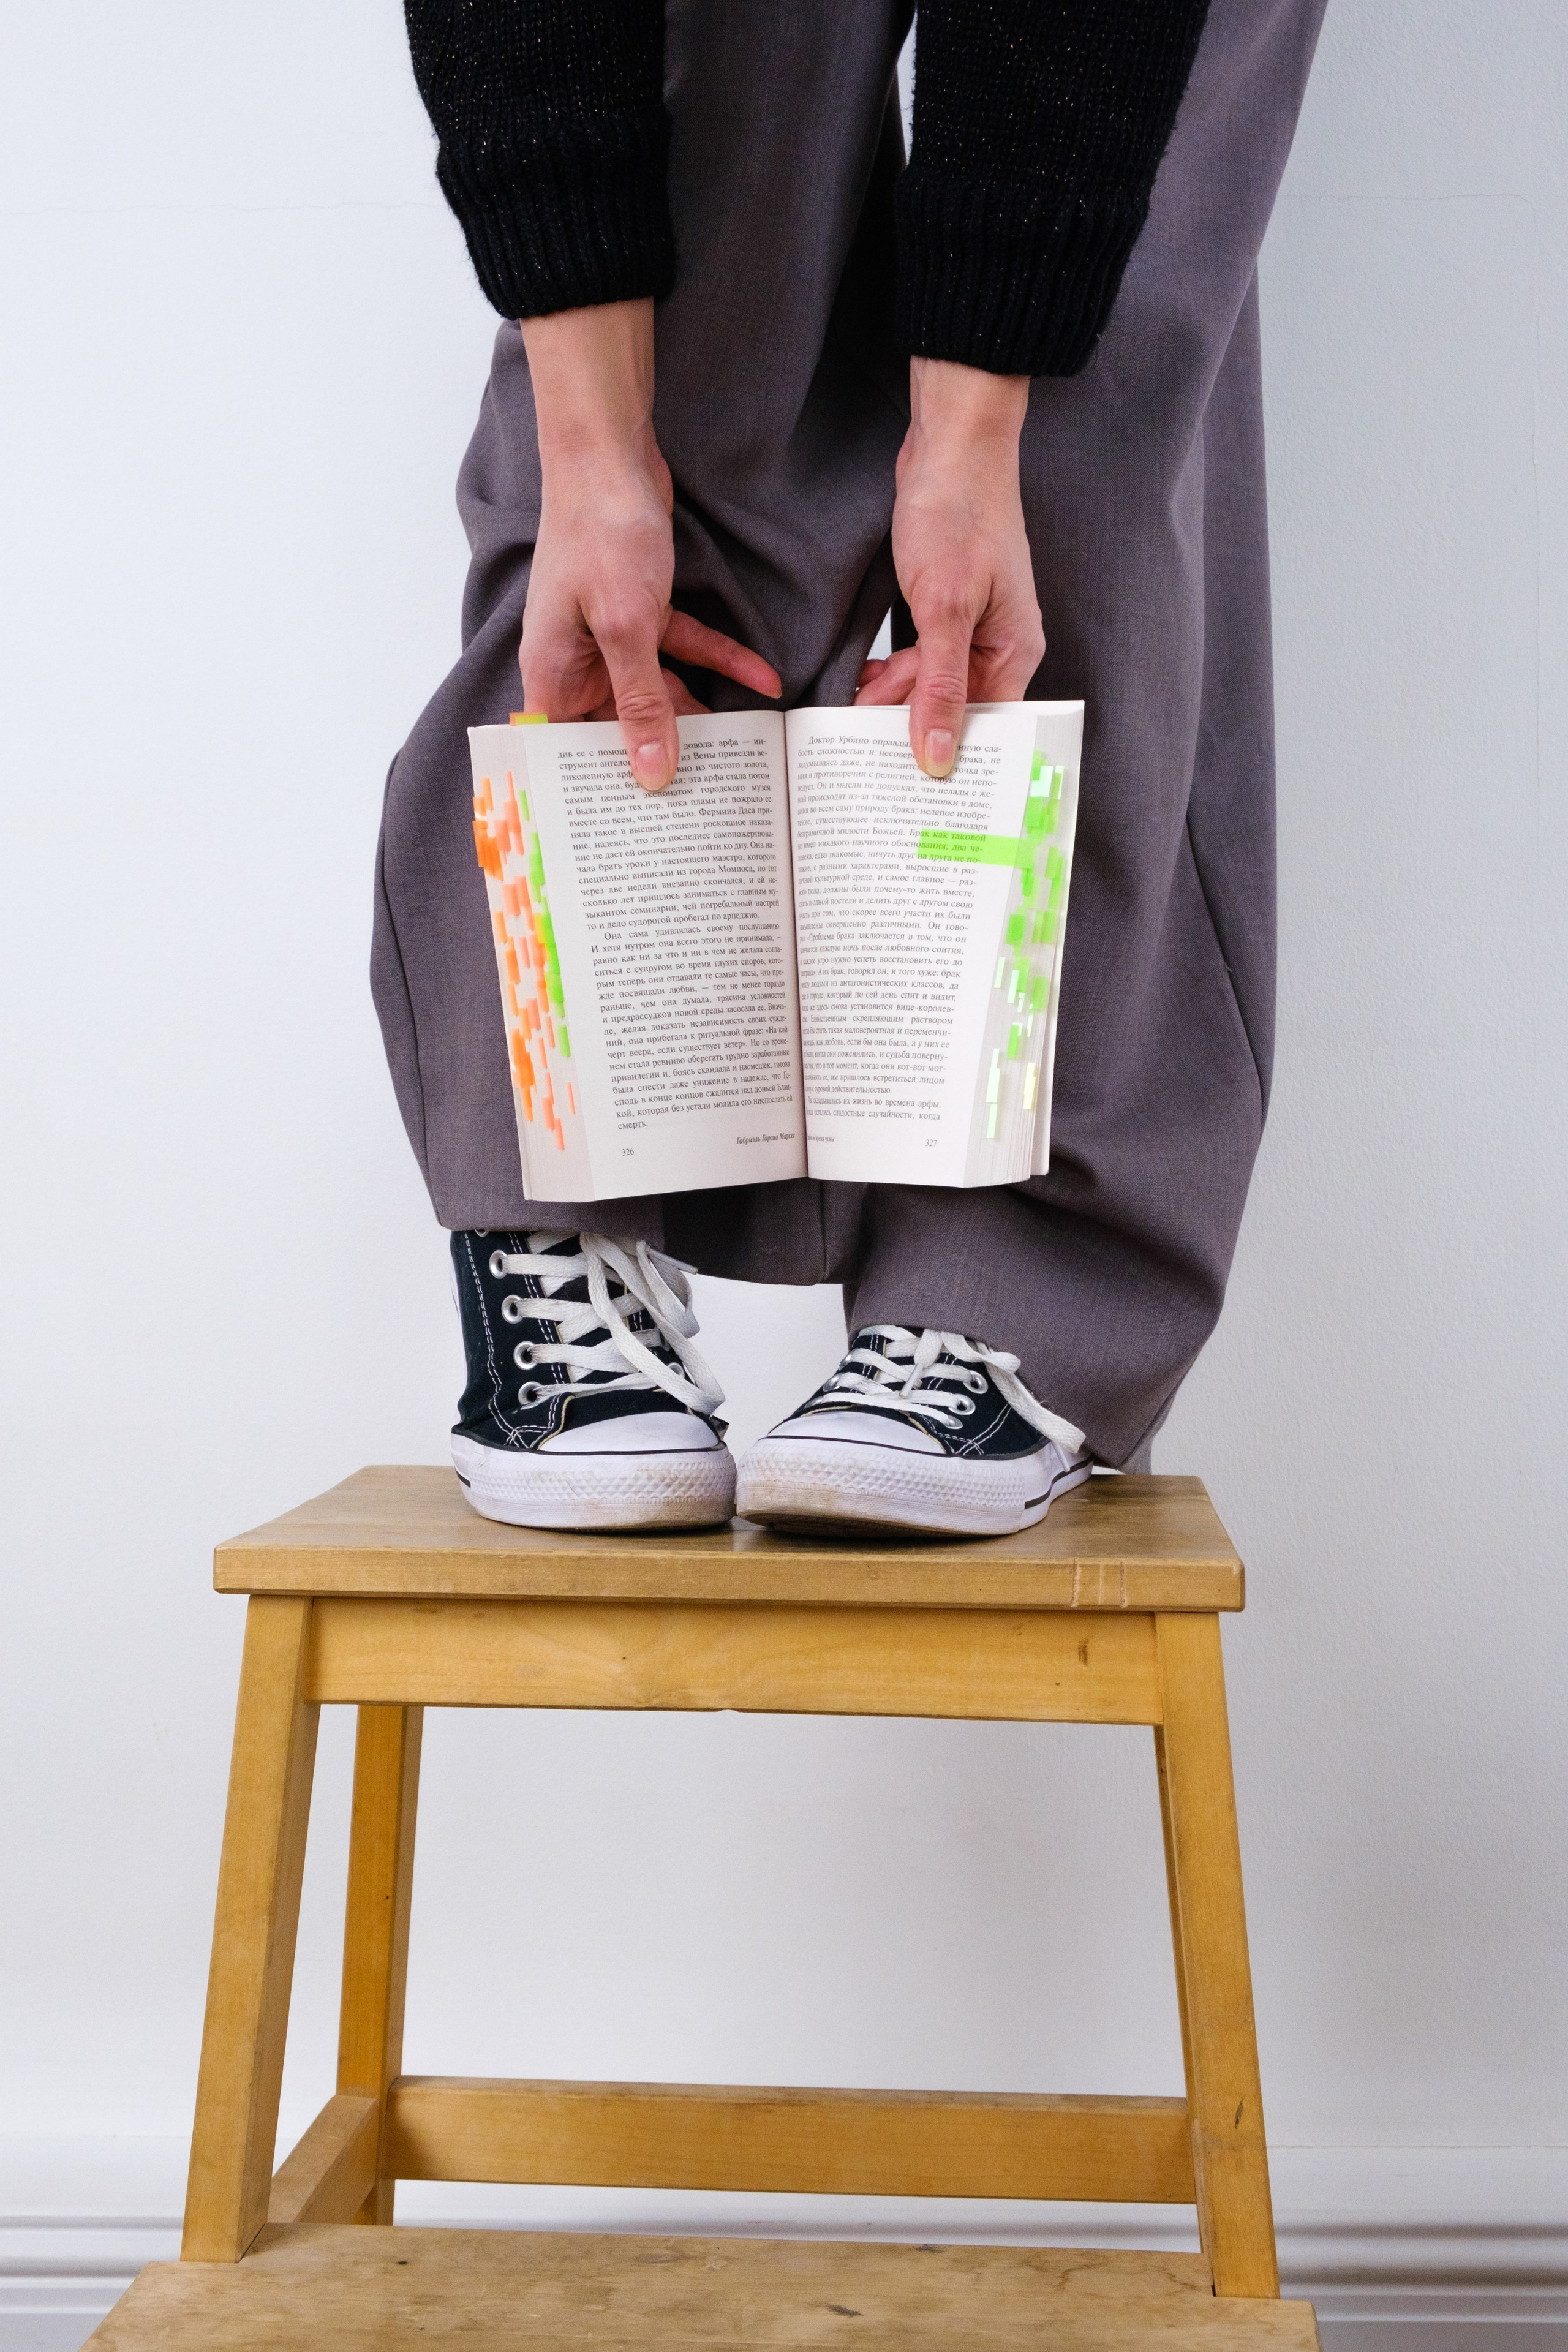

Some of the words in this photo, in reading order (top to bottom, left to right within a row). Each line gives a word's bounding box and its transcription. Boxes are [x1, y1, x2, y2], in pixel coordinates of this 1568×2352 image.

[808, 736, 835, 745] Доктор
[839, 736, 869, 745] Урбино
[561, 773, 614, 782] ликолепную
[643, 789, 693, 798] экспонатом
[701, 785, 745, 794] городского
[876, 783, 918, 793] допускал,
[699, 808, 736, 817] Фермина
[738, 807, 755, 815] Даса
[816, 817, 868, 826] существующее
[874, 818, 940, 826] исключительно
[945, 820, 988, 831] благодаря
[669, 833, 710, 842] последнее
[872, 827, 905, 835] Божьей.
[910, 829, 929, 838] Брак
[952, 832, 986, 842] таковой
[598, 862, 622, 872] брать
[625, 861, 650, 870] уроки
[662, 856, 709, 865] настоящего
[906, 864, 949, 873] выросшие
[943, 889, 974, 898] вместе,
[585, 910, 627, 918] зыкантом
[630, 905, 679, 915] семинарии,
[700, 900, 753, 910] погребальный
[755, 899, 779, 908] настрой
[628, 916, 671, 927] судорогой
[674, 914, 709, 924] пробегал
[723, 913, 760, 921] арпеджио.
[655, 927, 701, 937] удивлялась
[885, 943, 929, 952] любовного
[597, 981, 615, 990] рым
[600, 1003, 635, 1013] раньше,
[682, 997, 712, 1006] думала,
[717, 995, 746, 1003] трясина
[750, 991, 786, 1001] условностей
[651, 1022, 685, 1031] доказать
[690, 1018, 745, 1027] независимость
[652, 1058, 685, 1068] ревниво
[687, 1054, 724, 1064] оберегать
[726, 1053, 749, 1061] трудно
[751, 1049, 790, 1060] заработанные
[692, 1078, 729, 1088] унижение
[616, 1109, 635, 1118] кой,
[637, 1107, 669, 1117] которая
[686, 1103, 710, 1112] устали
[753, 1096, 786, 1105] ниспослать
[918, 1100, 941, 1110] арфы.
[868, 1110, 914, 1120] случайности,
[617, 1121, 648, 1130] смерть.
[736, 1136, 761, 1145] Габриэль
[761, 1134, 778, 1143] Гарсиа
[779, 1133, 796, 1141] Маркес
[622, 1147, 635, 1156] 326
